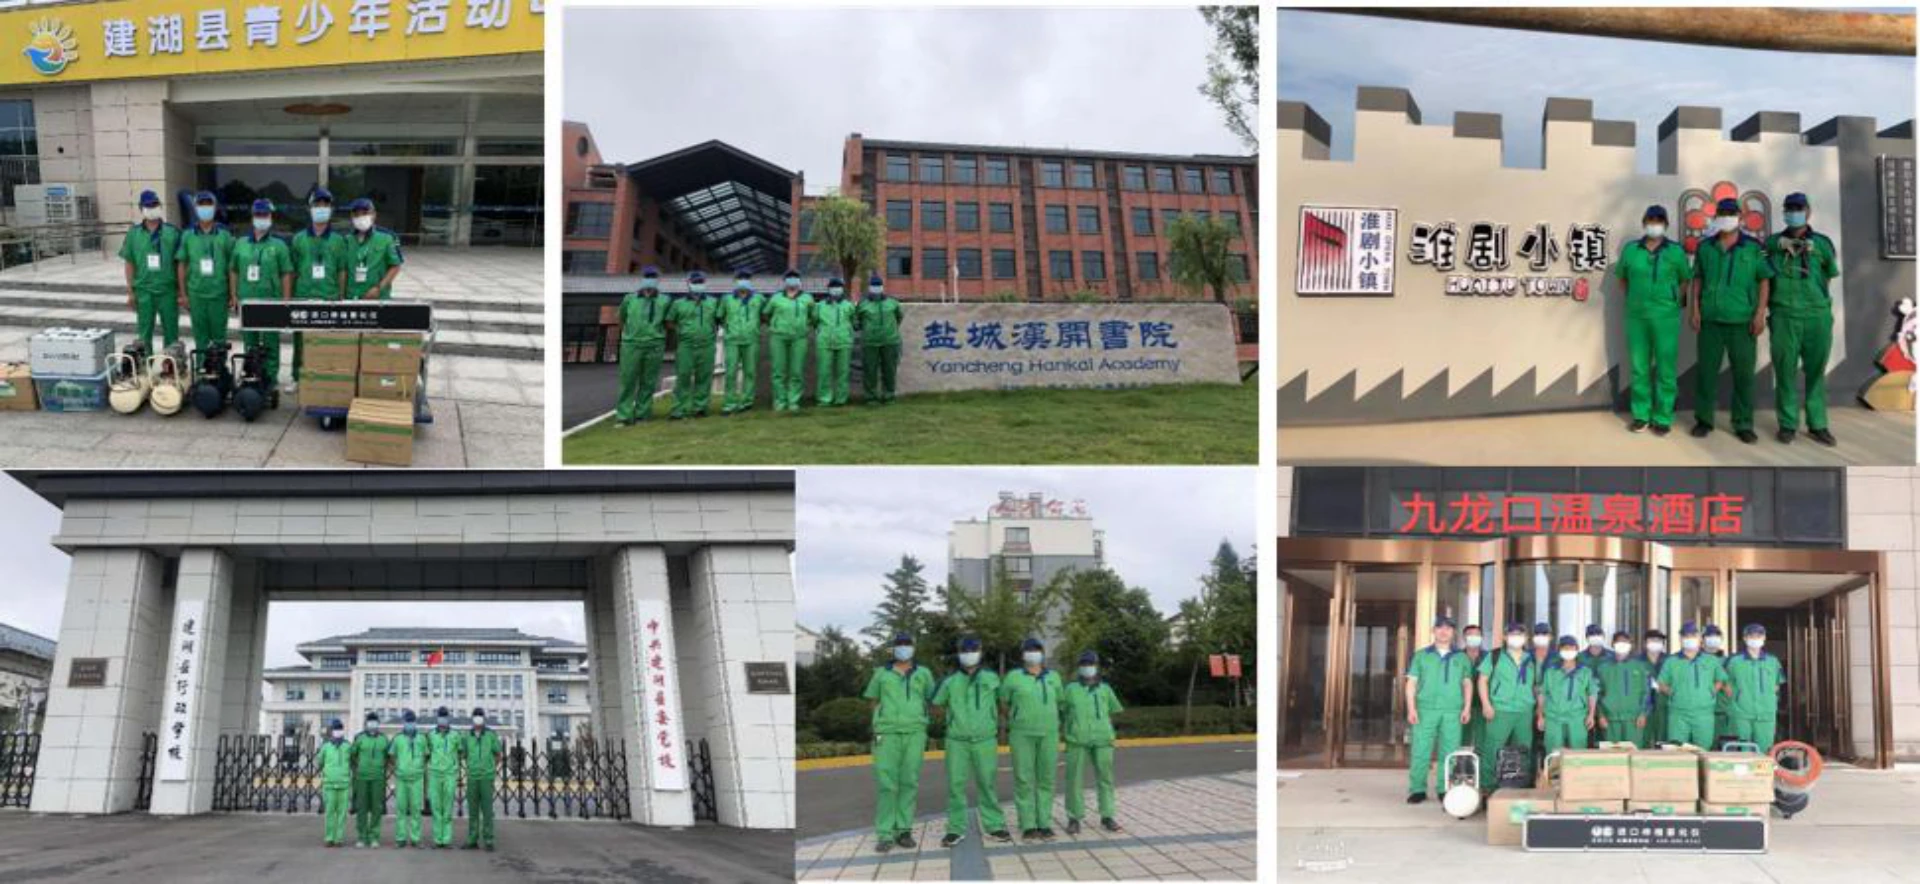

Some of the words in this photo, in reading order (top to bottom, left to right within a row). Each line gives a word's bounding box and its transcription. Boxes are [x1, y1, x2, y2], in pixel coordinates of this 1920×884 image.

[103, 0, 544, 58] 建湖县青少年活动
[1408, 222, 1609, 272] 淮剧小镇
[921, 319, 1179, 351] 盐城漢開書院
[926, 359, 1024, 376] Yancheng
[1100, 357, 1182, 374] Academy
[1400, 491, 1744, 535] 九龙口温泉酒店
